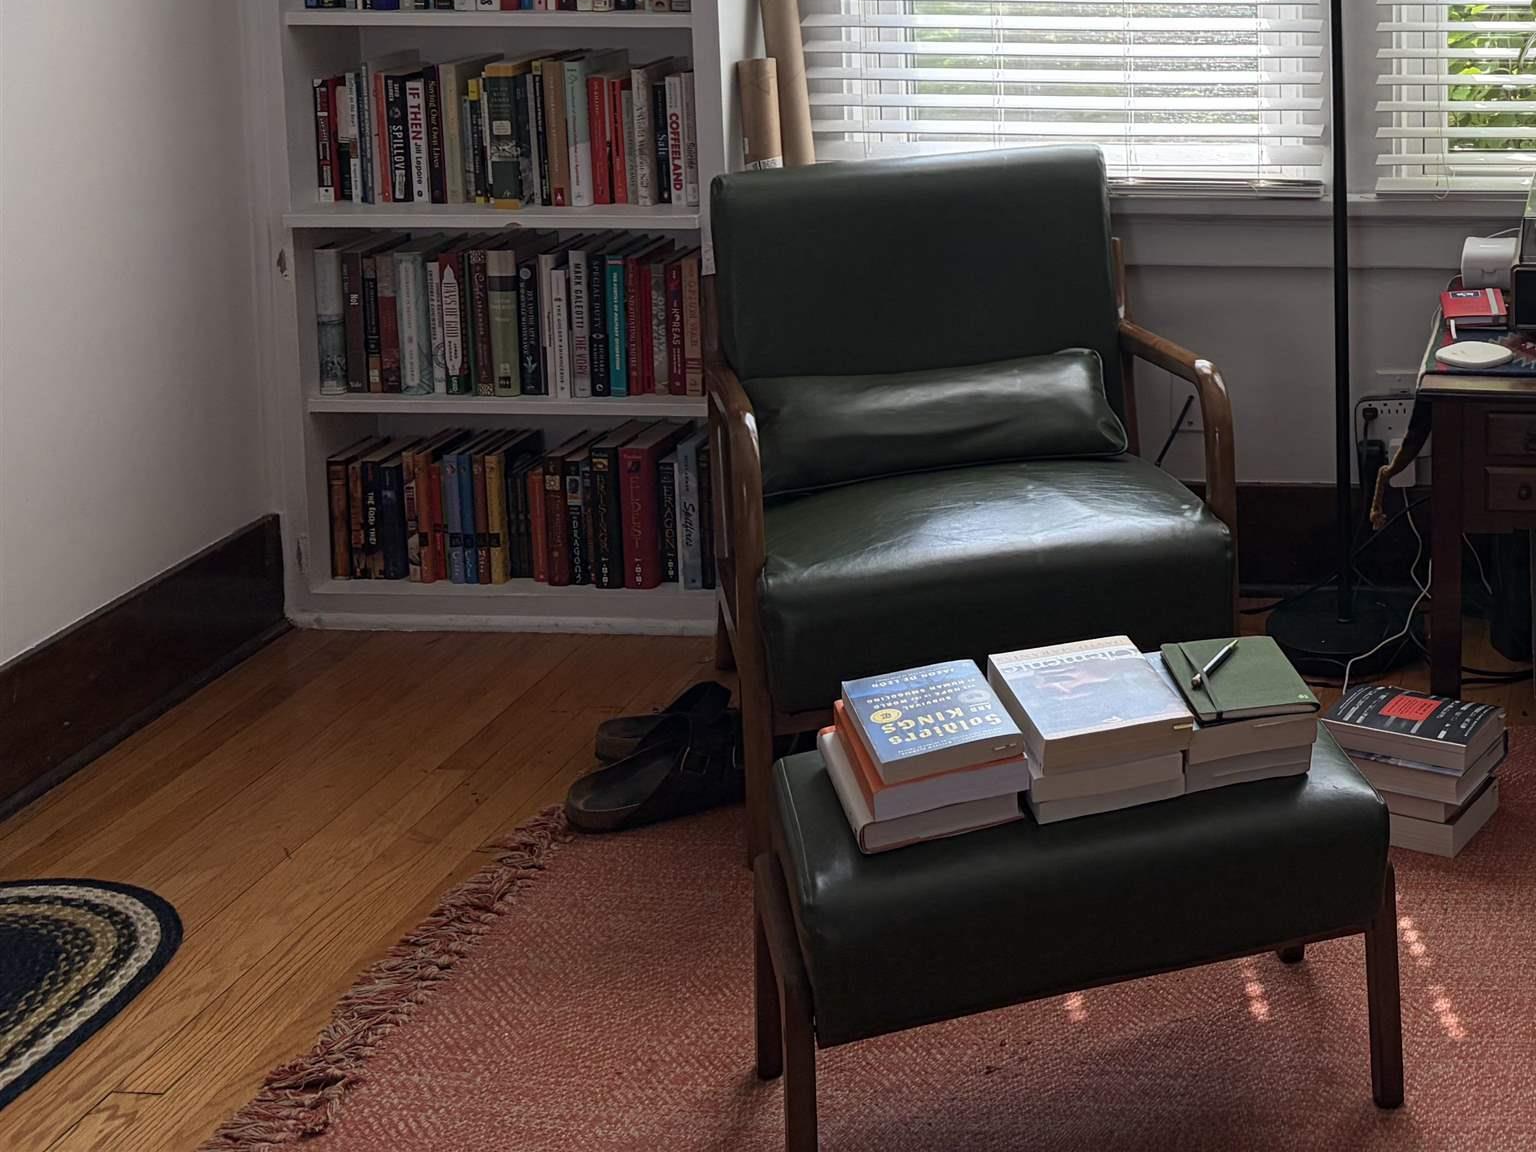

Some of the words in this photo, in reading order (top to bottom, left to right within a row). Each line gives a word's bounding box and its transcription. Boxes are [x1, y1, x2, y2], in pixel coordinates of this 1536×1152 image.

[407, 87, 420, 99] IF
[409, 104, 423, 141] THEN
[414, 142, 423, 156] Jill
[657, 132, 669, 156] Salt
[668, 113, 684, 191] COFFEELAND
[414, 157, 424, 185] Lepore
[573, 264, 582, 286] MARK
[443, 282, 459, 305] DAYS
[444, 308, 459, 319] OF
[445, 321, 460, 339] GOD
[681, 501, 696, 547] Spitfires
[881, 706, 965, 735] KINGS
[888, 712, 1004, 746] Soldiers
